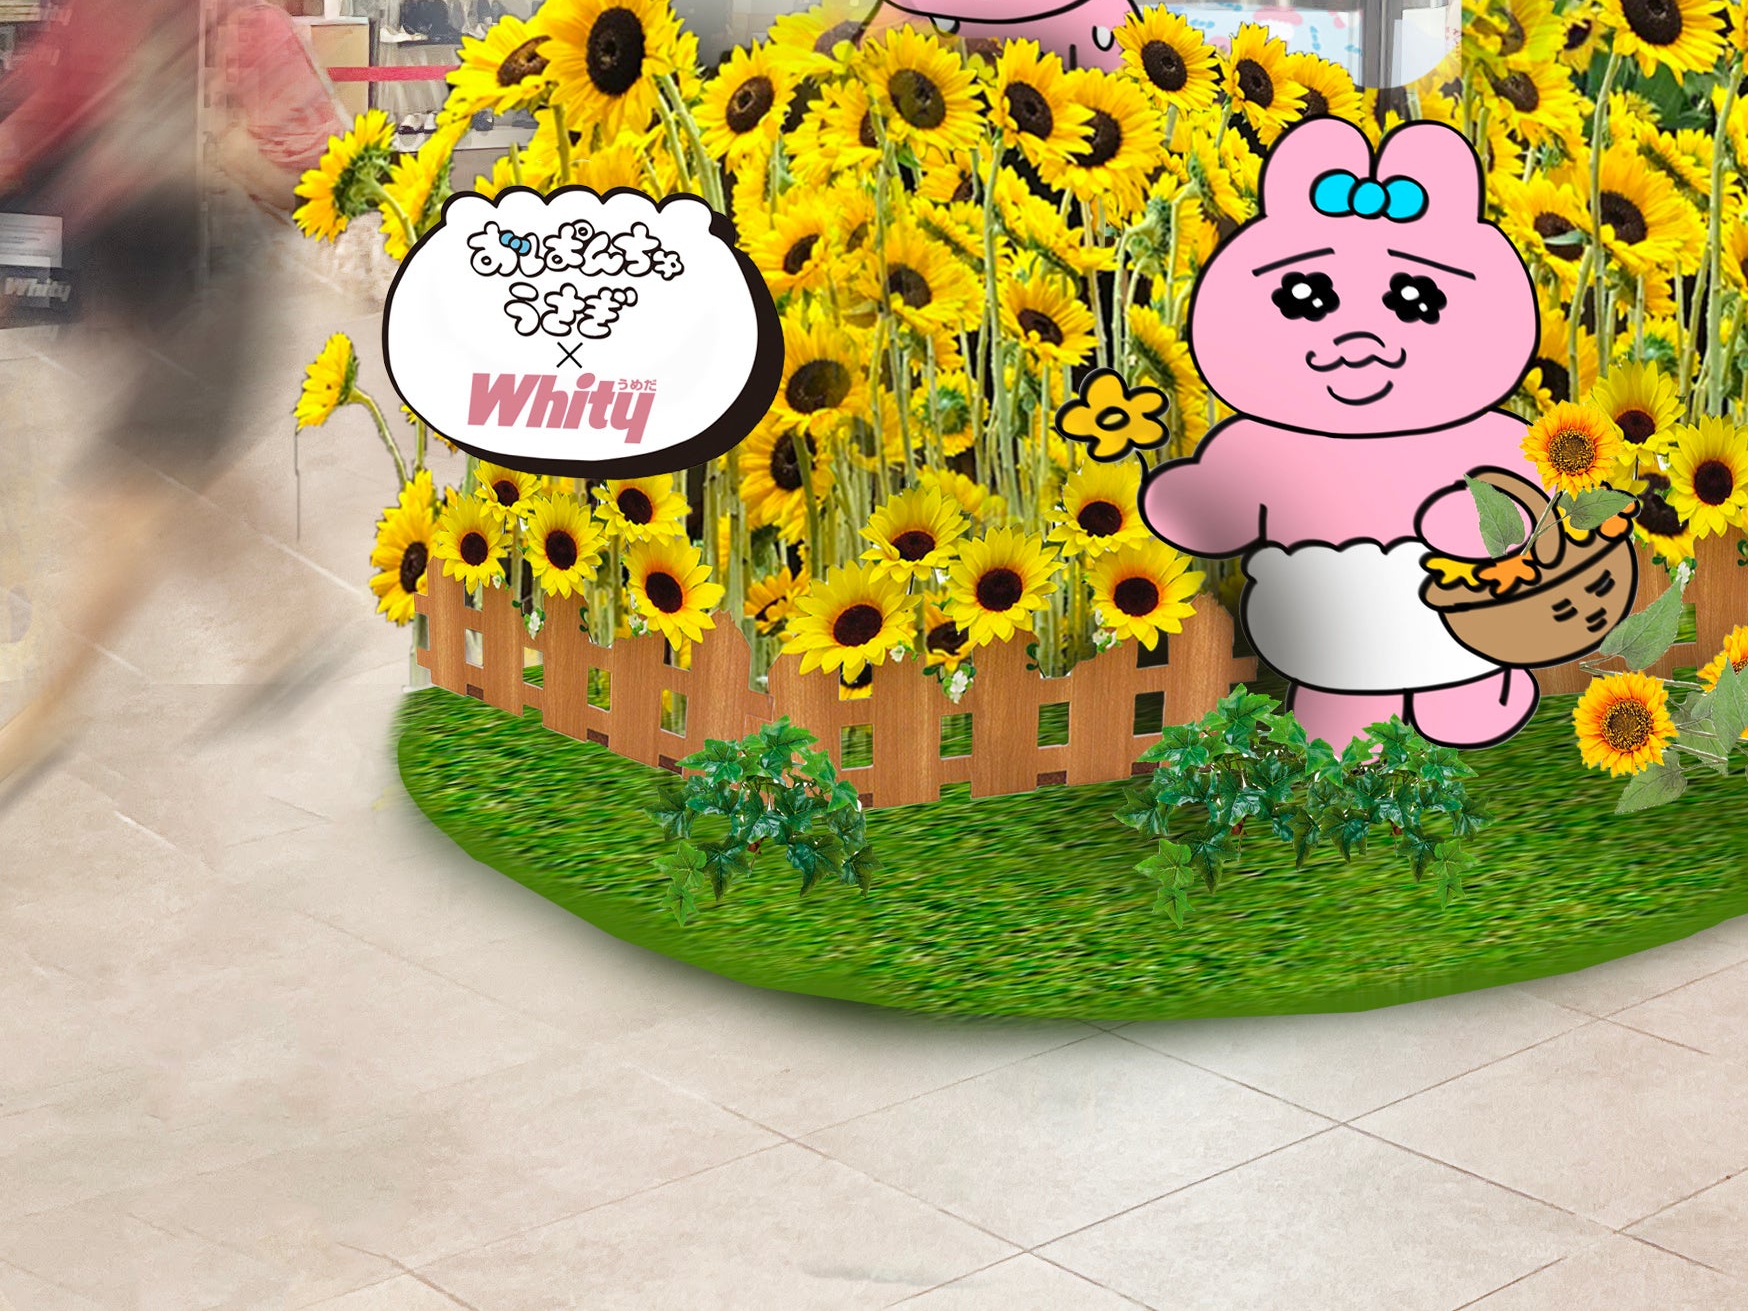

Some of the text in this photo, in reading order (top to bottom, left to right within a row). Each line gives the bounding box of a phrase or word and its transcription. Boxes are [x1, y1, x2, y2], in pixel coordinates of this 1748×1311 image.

[503, 281, 638, 339] うさぎ
[467, 372, 656, 444] Whity
[617, 378, 657, 392] うめだ
